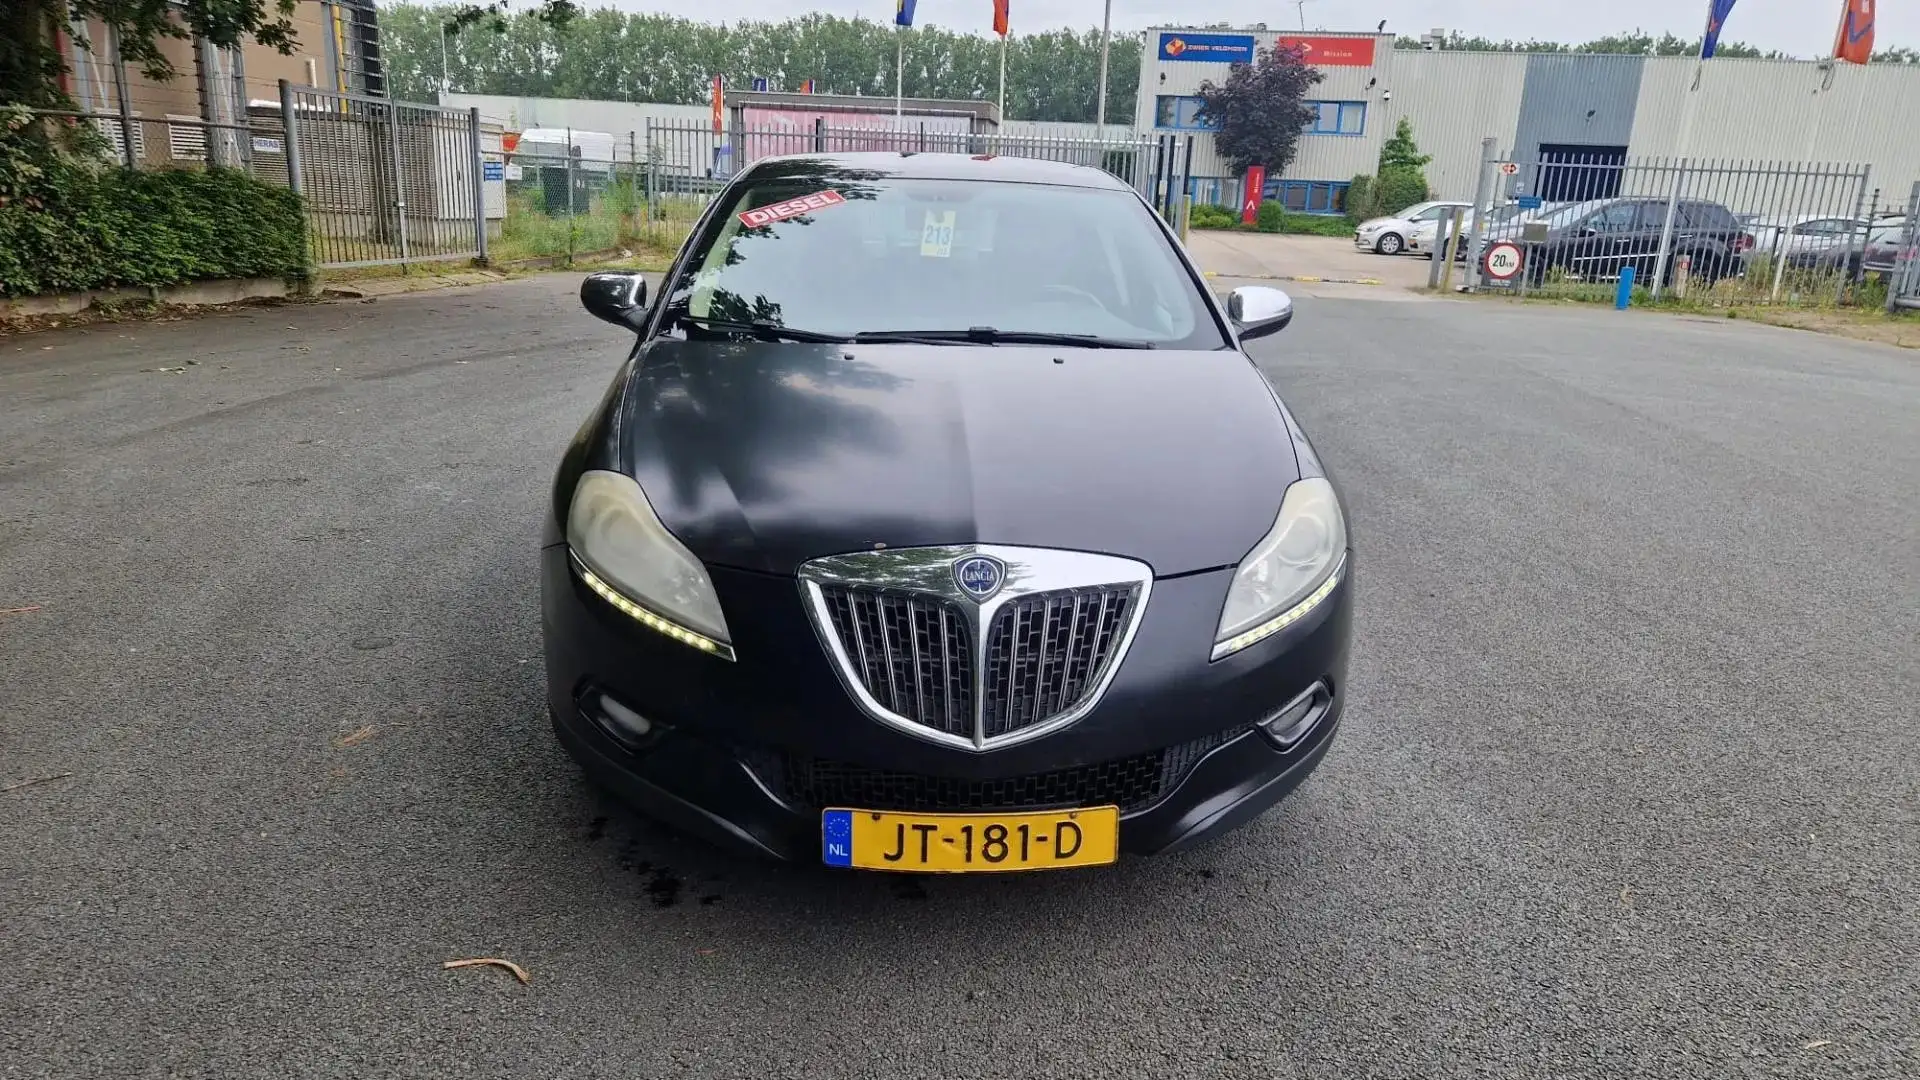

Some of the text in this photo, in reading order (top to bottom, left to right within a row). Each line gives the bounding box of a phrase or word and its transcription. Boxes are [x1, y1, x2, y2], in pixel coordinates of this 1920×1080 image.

[749, 191, 839, 224] DIESEL
[924, 224, 951, 245] 213
[1492, 254, 1506, 268] 20
[965, 569, 995, 582] LANCIA
[829, 844, 848, 857] NL
[883, 821, 1082, 863] JT-181-D
